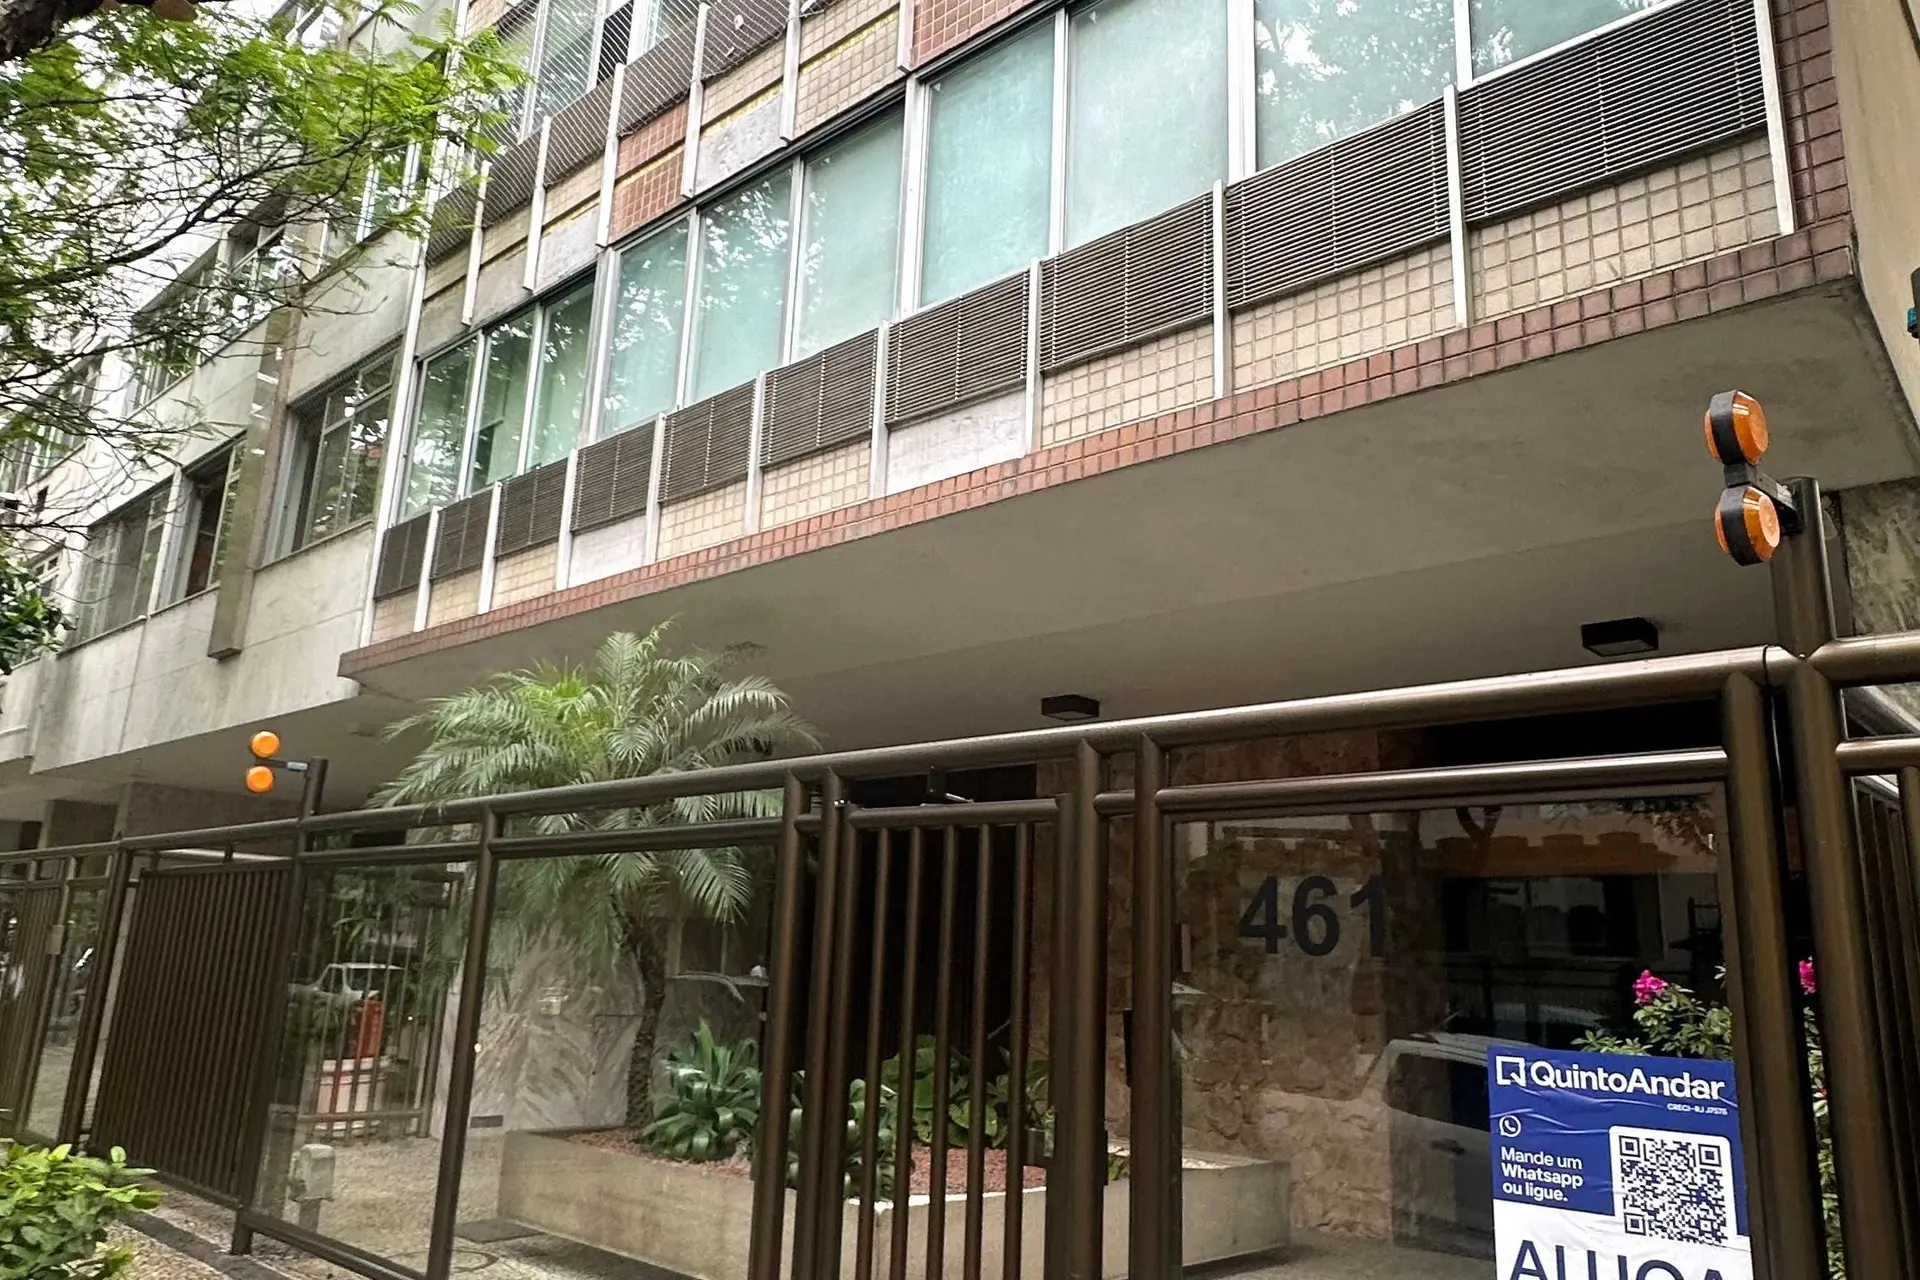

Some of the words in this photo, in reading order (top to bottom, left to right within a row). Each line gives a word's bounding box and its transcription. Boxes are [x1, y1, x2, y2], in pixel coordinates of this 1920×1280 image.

[1238, 874, 1385, 957] 461
[1530, 1060, 1725, 1100] QuintoAndar
[1501, 1146, 1554, 1167] Mande
[1556, 1156, 1583, 1170] um
[1501, 1162, 1584, 1190] Whatsapp
[1502, 1182, 1523, 1196] ou
[1524, 1181, 1569, 1202] ligue.
